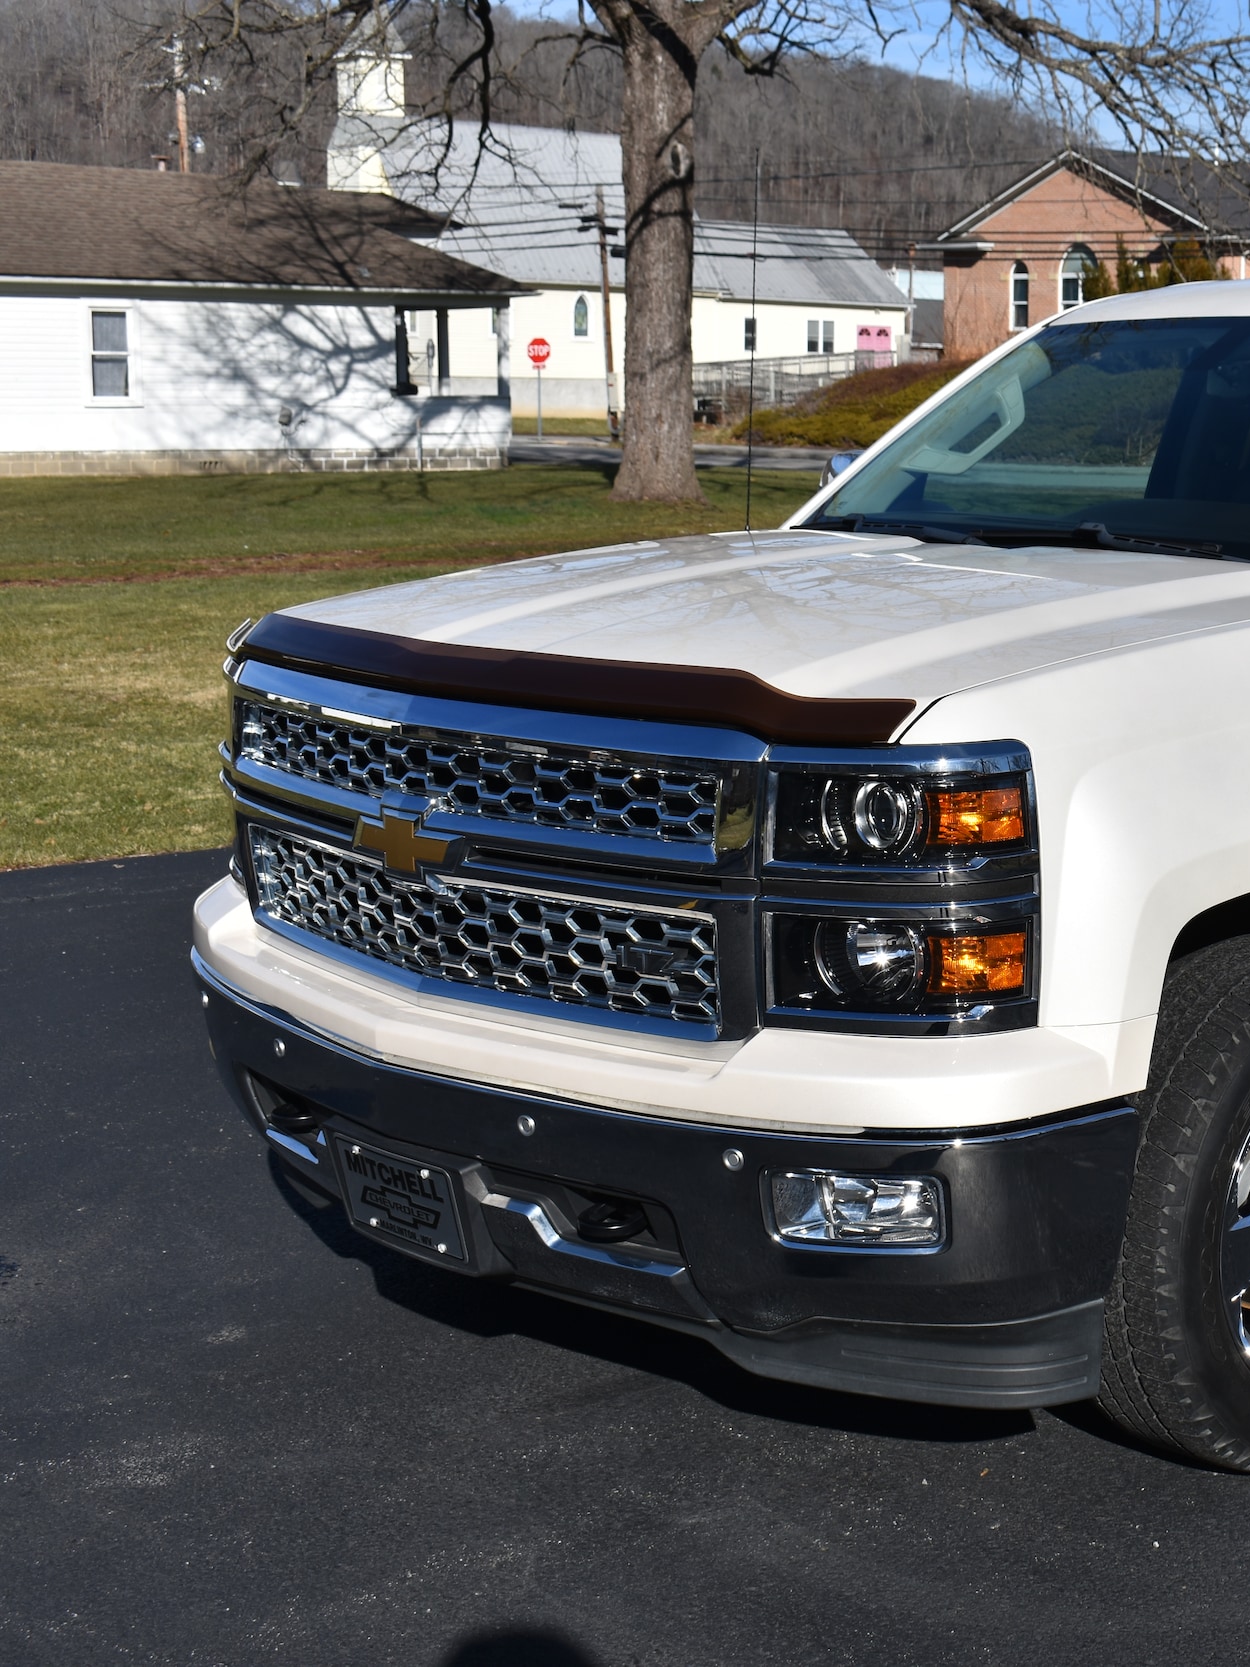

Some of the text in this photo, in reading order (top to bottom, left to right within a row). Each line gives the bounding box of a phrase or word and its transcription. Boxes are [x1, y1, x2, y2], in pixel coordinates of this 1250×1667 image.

[529, 345, 550, 356] STOP
[344, 1149, 445, 1204] MITCHELL
[368, 1191, 431, 1221] CHEVROLET
